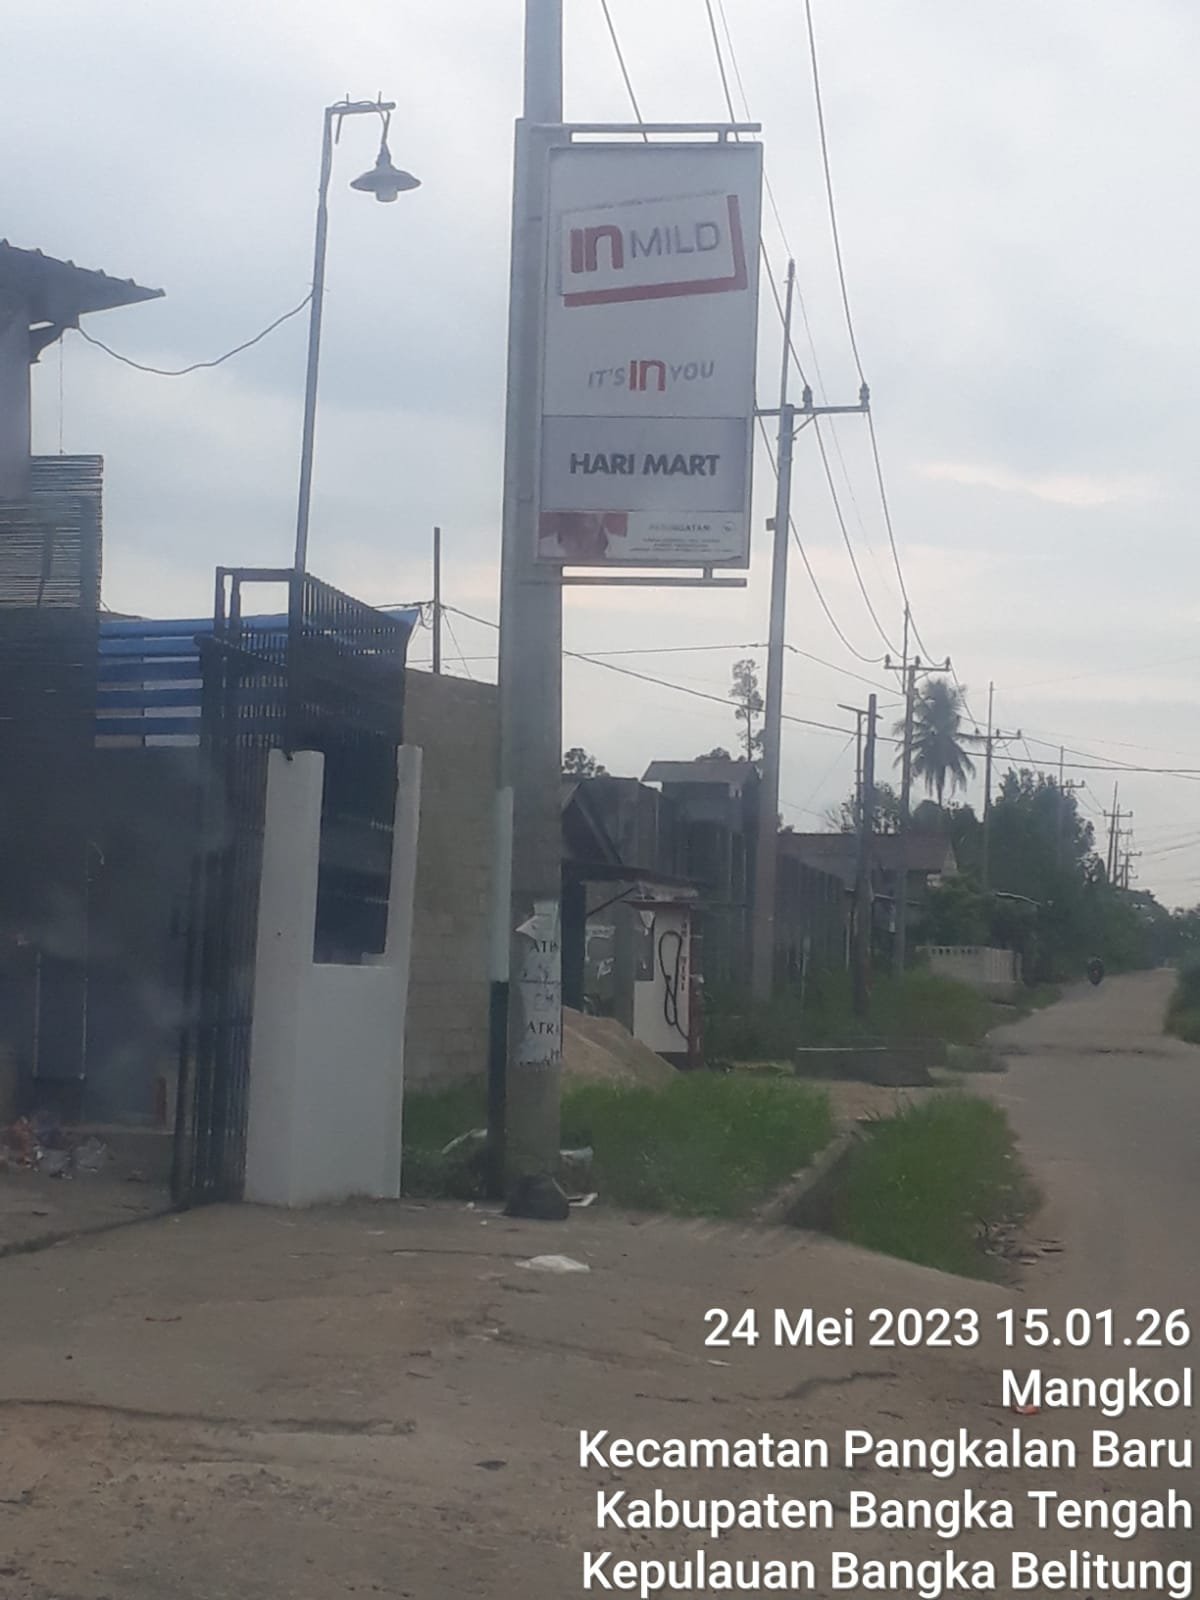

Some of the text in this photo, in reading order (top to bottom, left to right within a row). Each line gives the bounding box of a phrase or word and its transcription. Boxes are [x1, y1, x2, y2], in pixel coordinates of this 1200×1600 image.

[630, 221, 721, 259] MILD
[588, 367, 626, 388] IT'S
[670, 360, 715, 382] YOU
[569, 452, 721, 477] HARI MART
